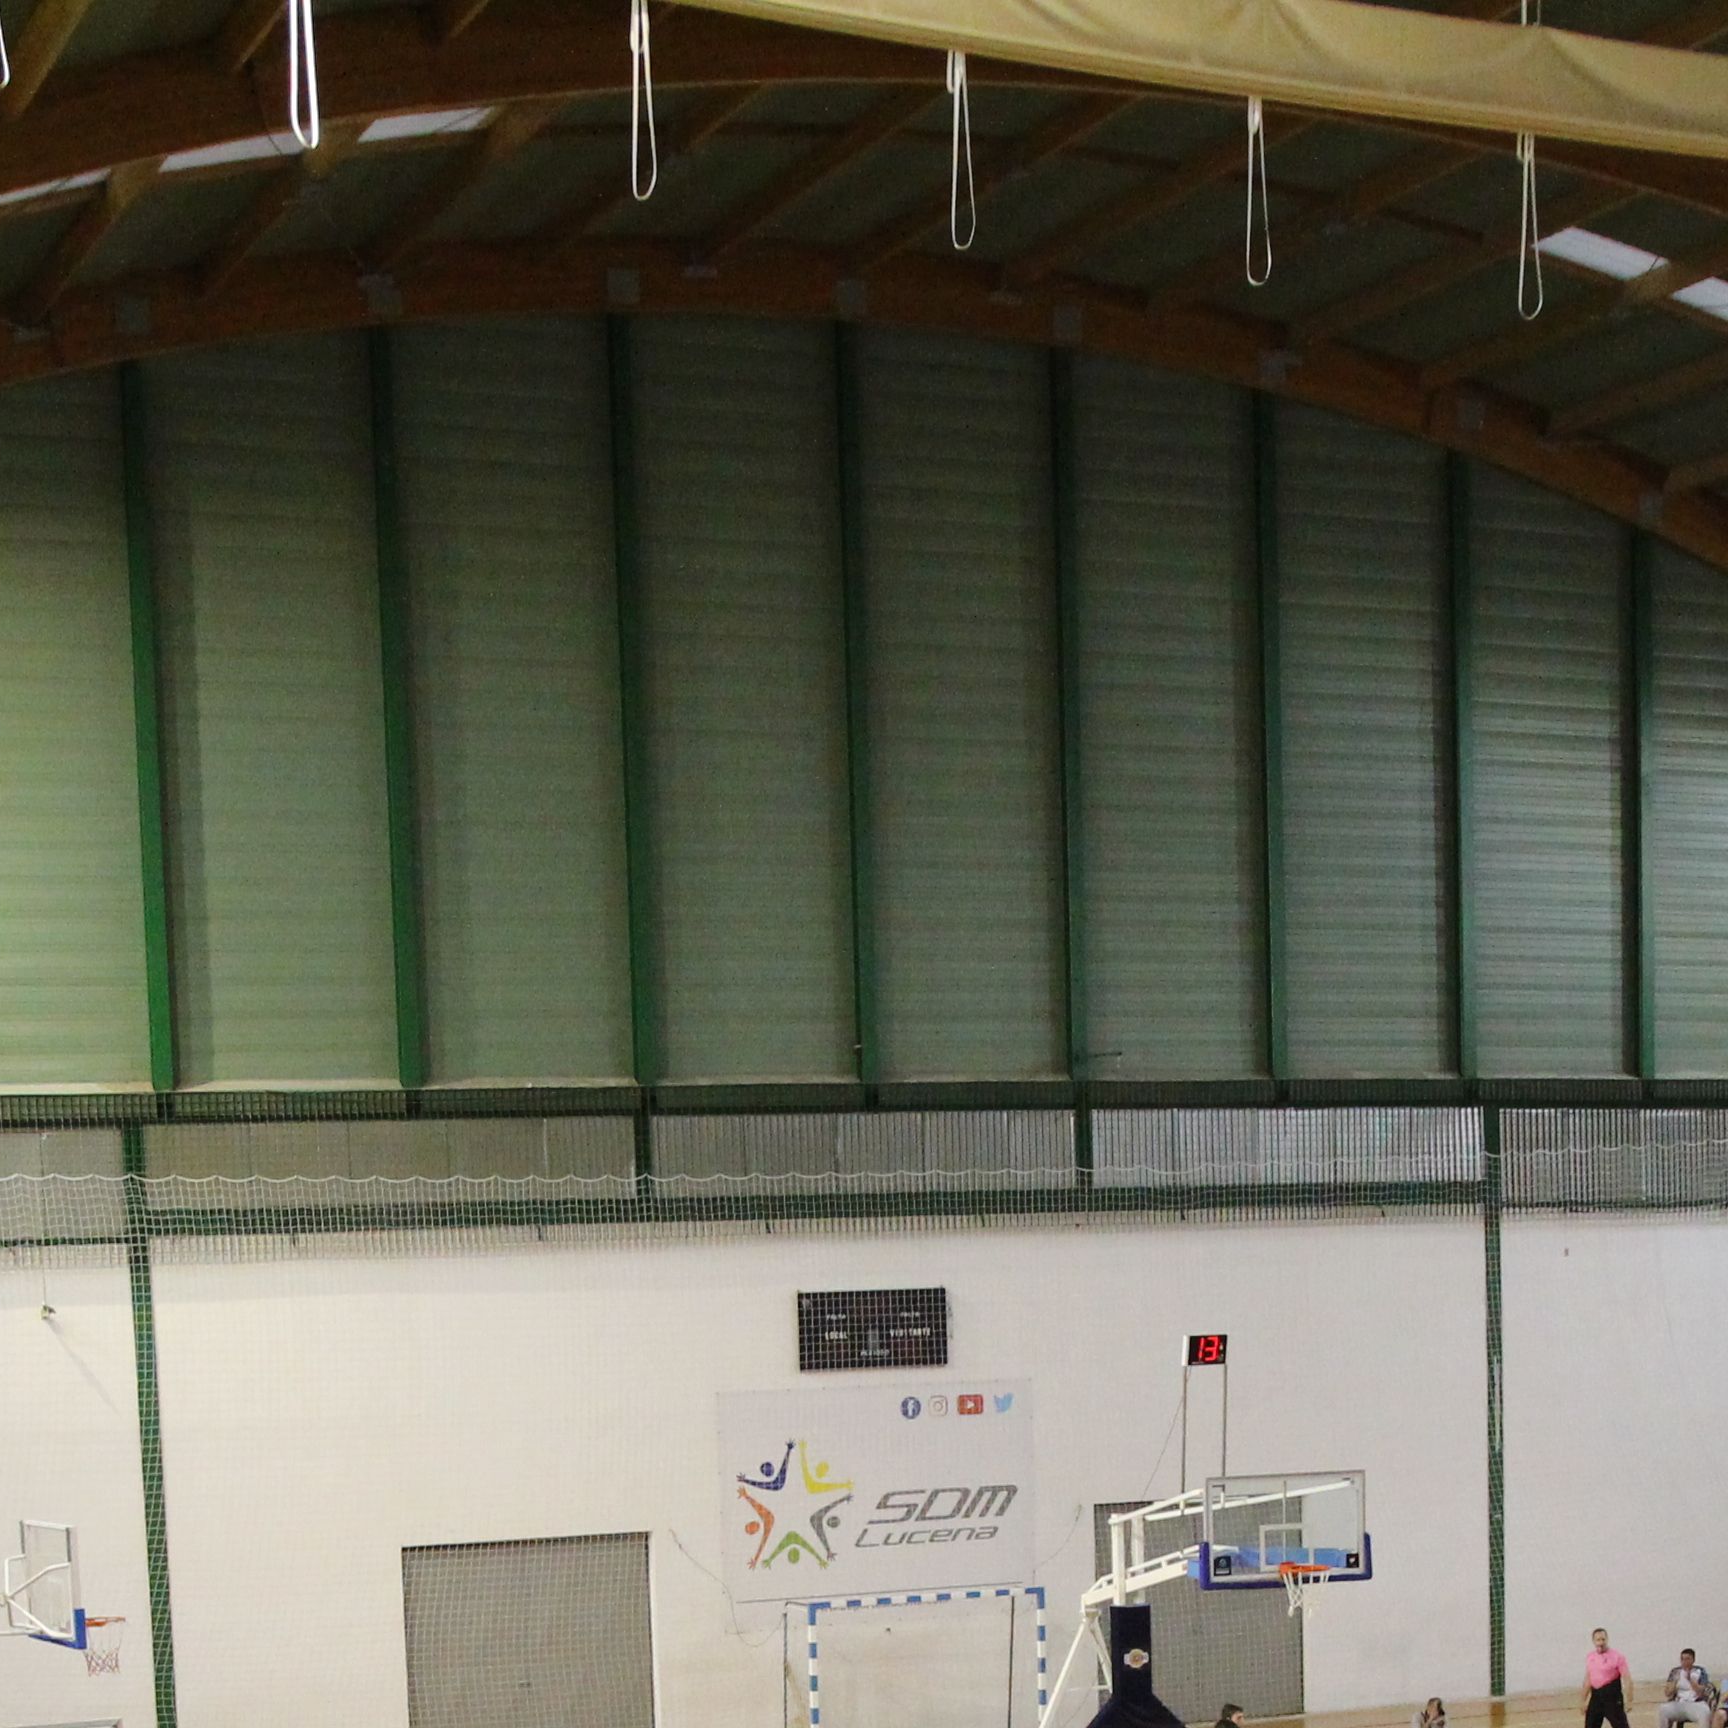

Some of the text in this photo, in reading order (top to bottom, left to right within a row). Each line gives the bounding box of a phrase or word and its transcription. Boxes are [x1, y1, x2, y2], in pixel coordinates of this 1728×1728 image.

[1198, 1335, 1219, 1362] 13
[866, 1484, 1019, 1525] SDM
[854, 1525, 999, 1548] Lucena
